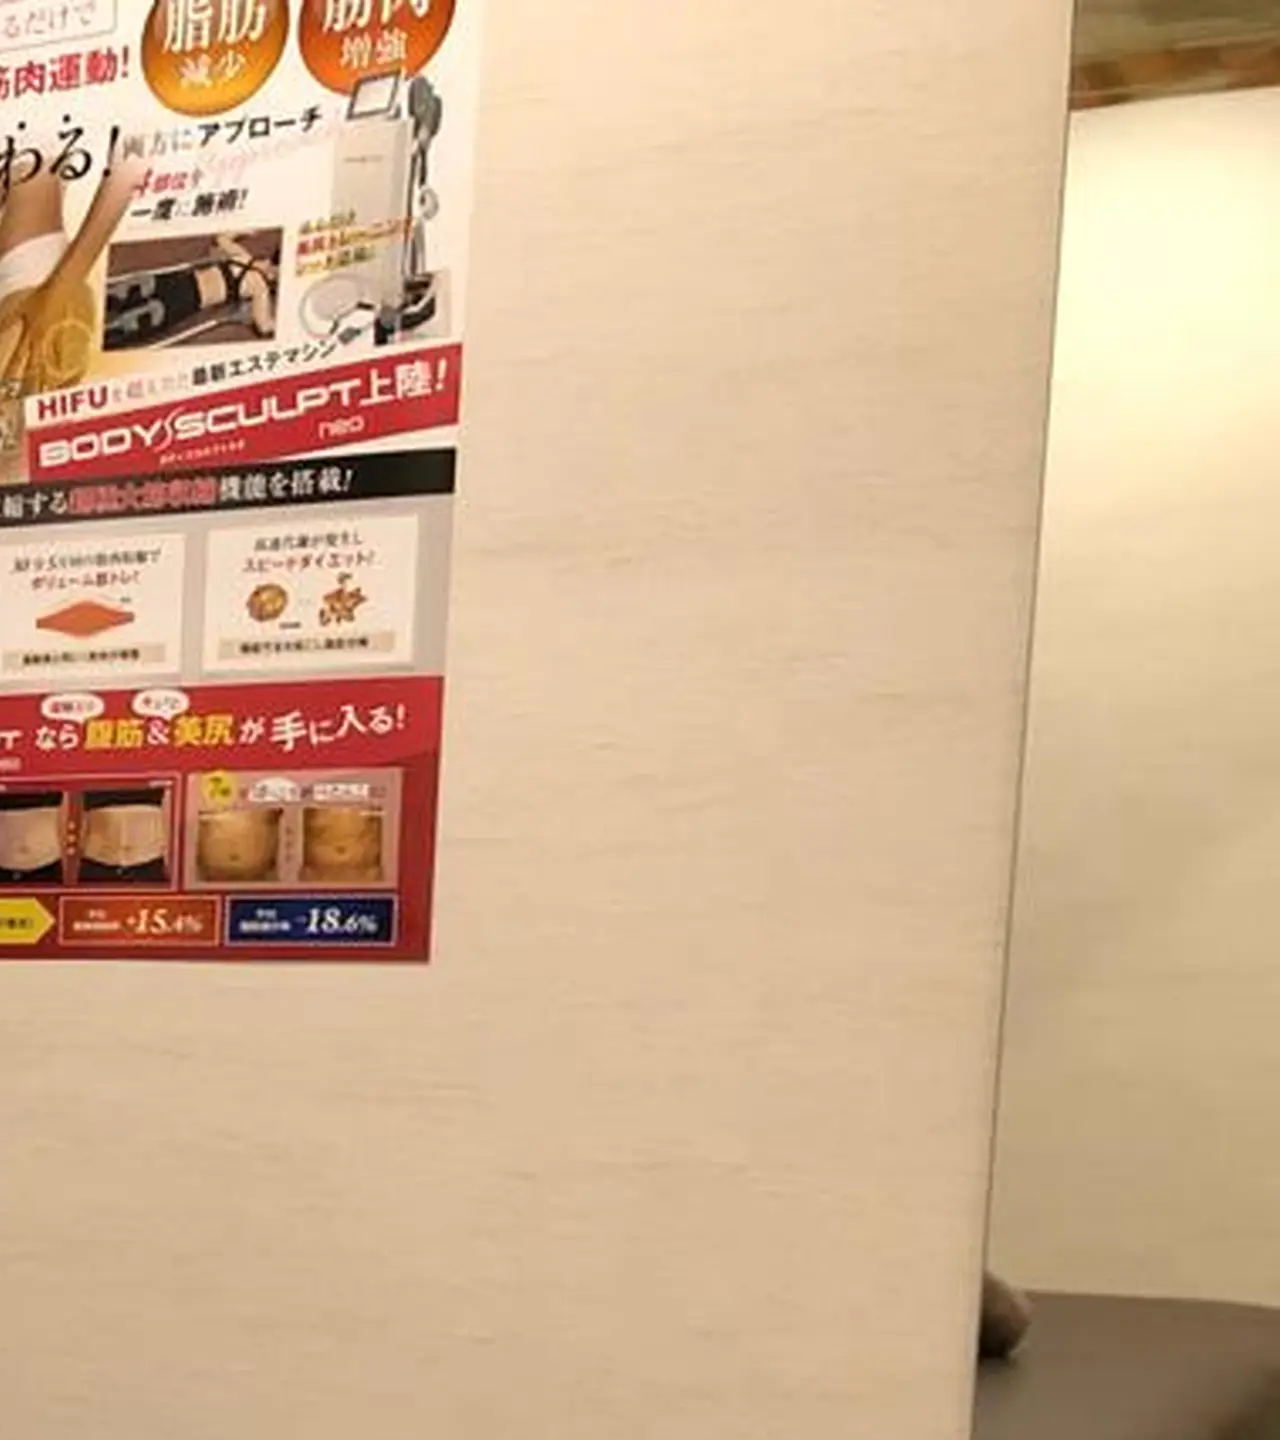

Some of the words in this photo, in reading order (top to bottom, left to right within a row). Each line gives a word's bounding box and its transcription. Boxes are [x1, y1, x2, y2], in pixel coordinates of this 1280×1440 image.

[161, 0, 268, 53] 脂肪
[340, 32, 408, 68] 増強
[180, 50, 247, 88] 減少
[317, 416, 365, 440] neo
